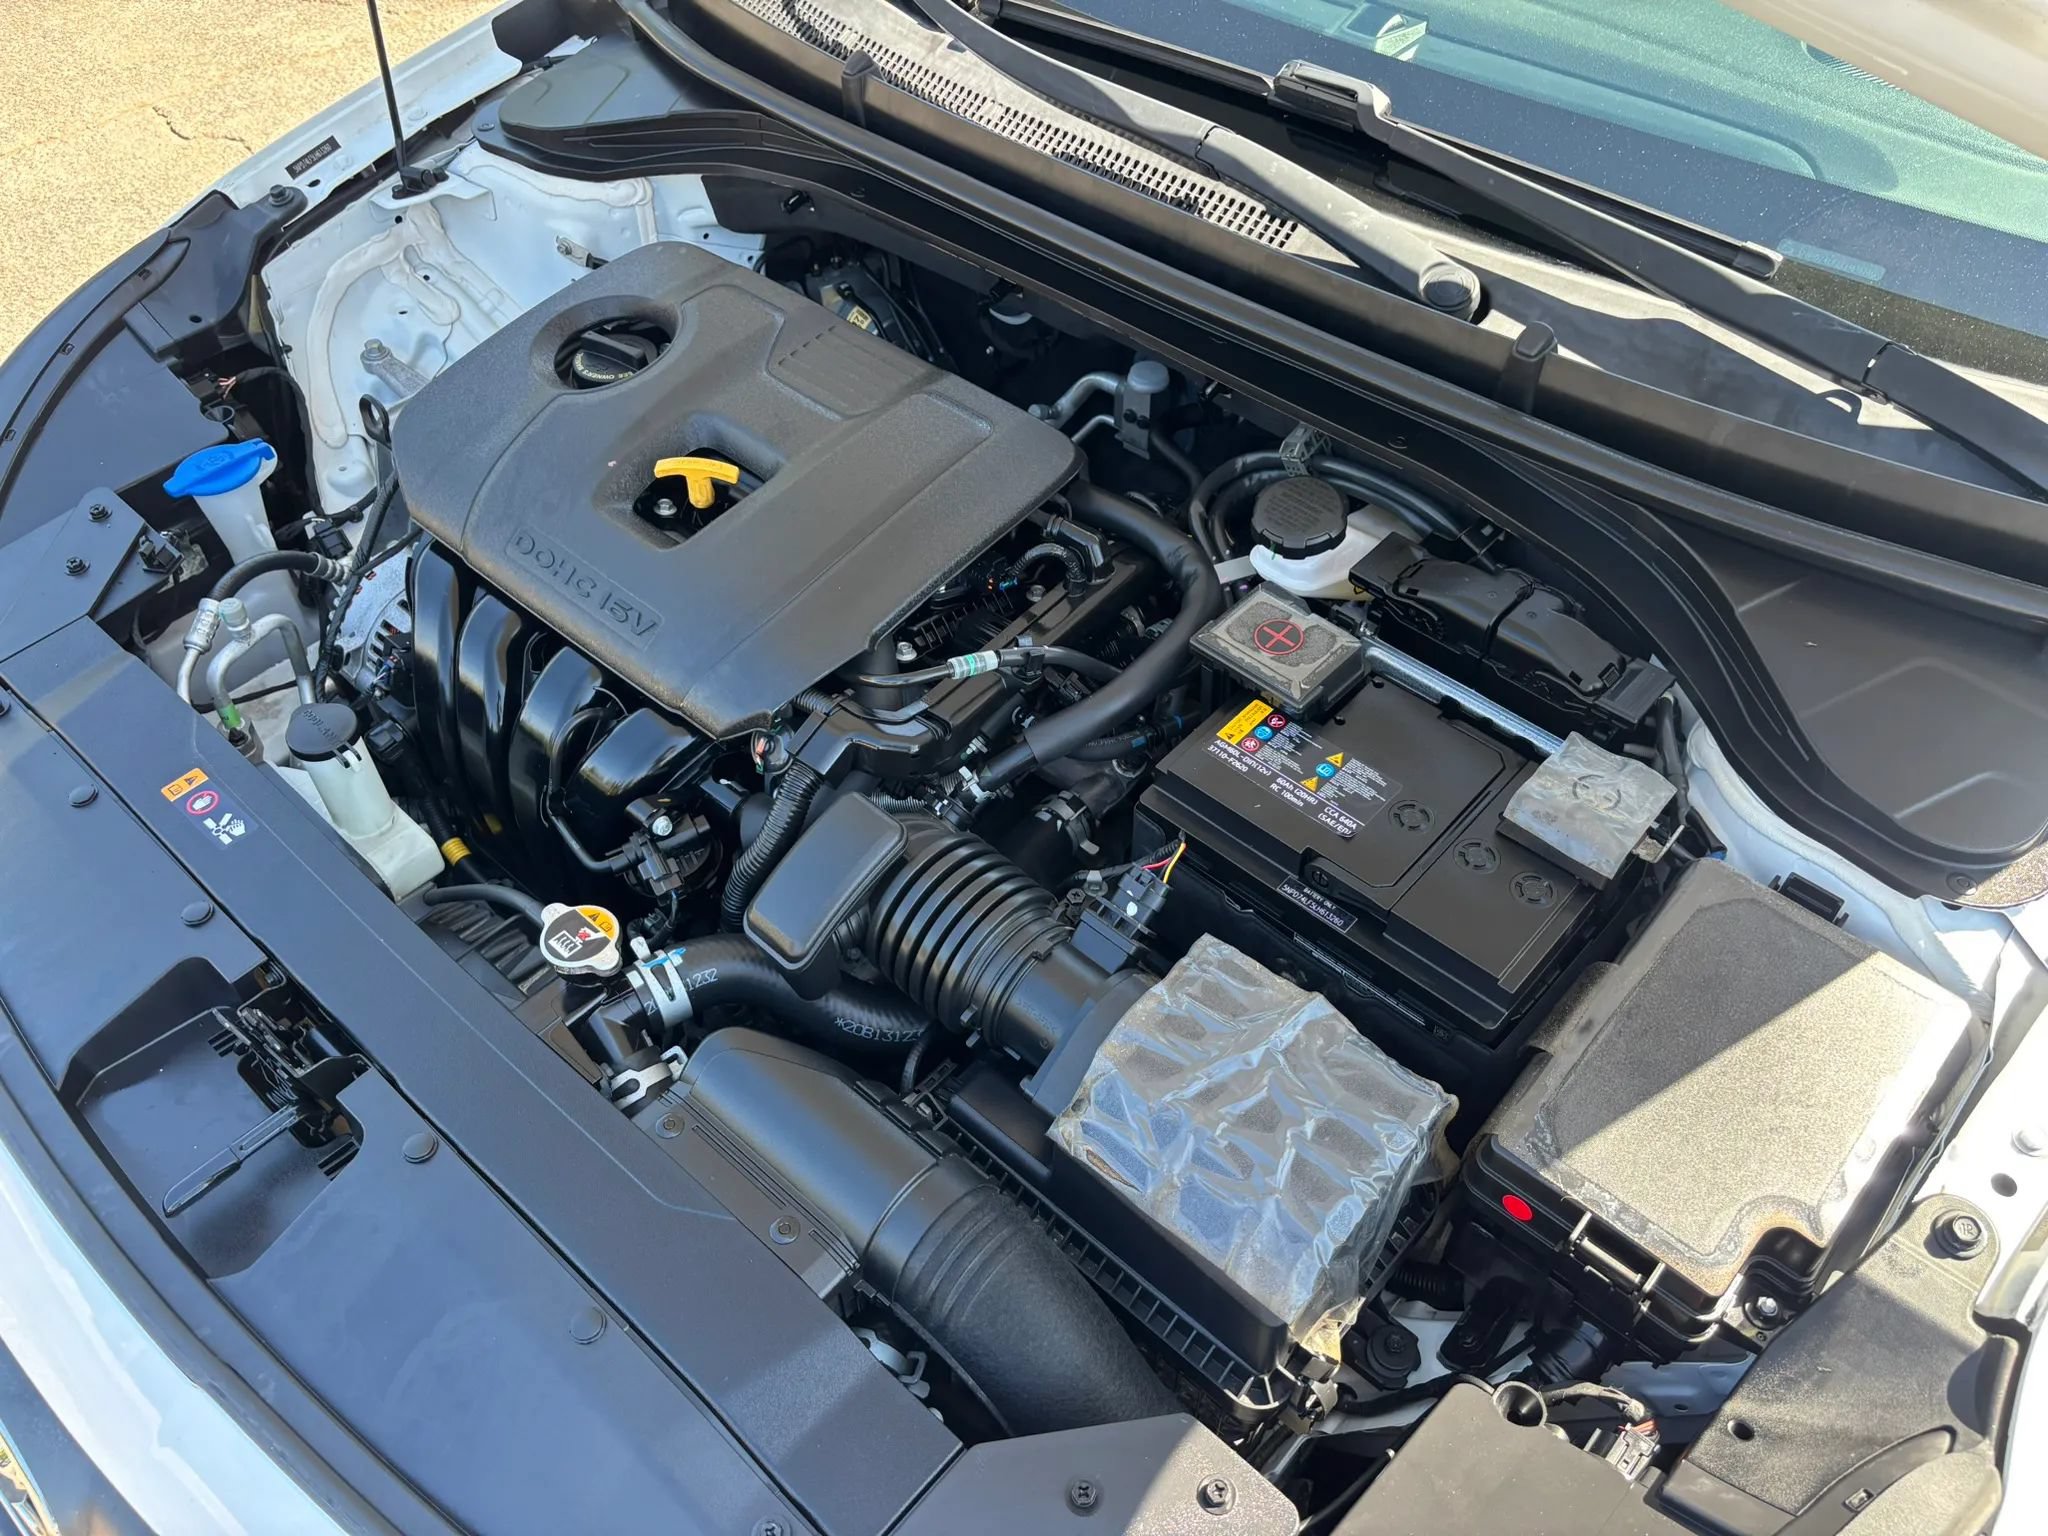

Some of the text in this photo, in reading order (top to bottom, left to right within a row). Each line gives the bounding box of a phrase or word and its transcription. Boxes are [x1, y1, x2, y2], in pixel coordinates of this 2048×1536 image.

[582, 369, 615, 380] OWNER'S
[516, 532, 656, 636] DOHC 16V
[1270, 783, 1281, 792] RC
[1280, 789, 1304, 807] 100min
[1276, 777, 1294, 791] 60Ah
[1294, 788, 1318, 805] (20HR)
[1324, 806, 1357, 830] CCA 640A
[686, 967, 718, 991] 1232
